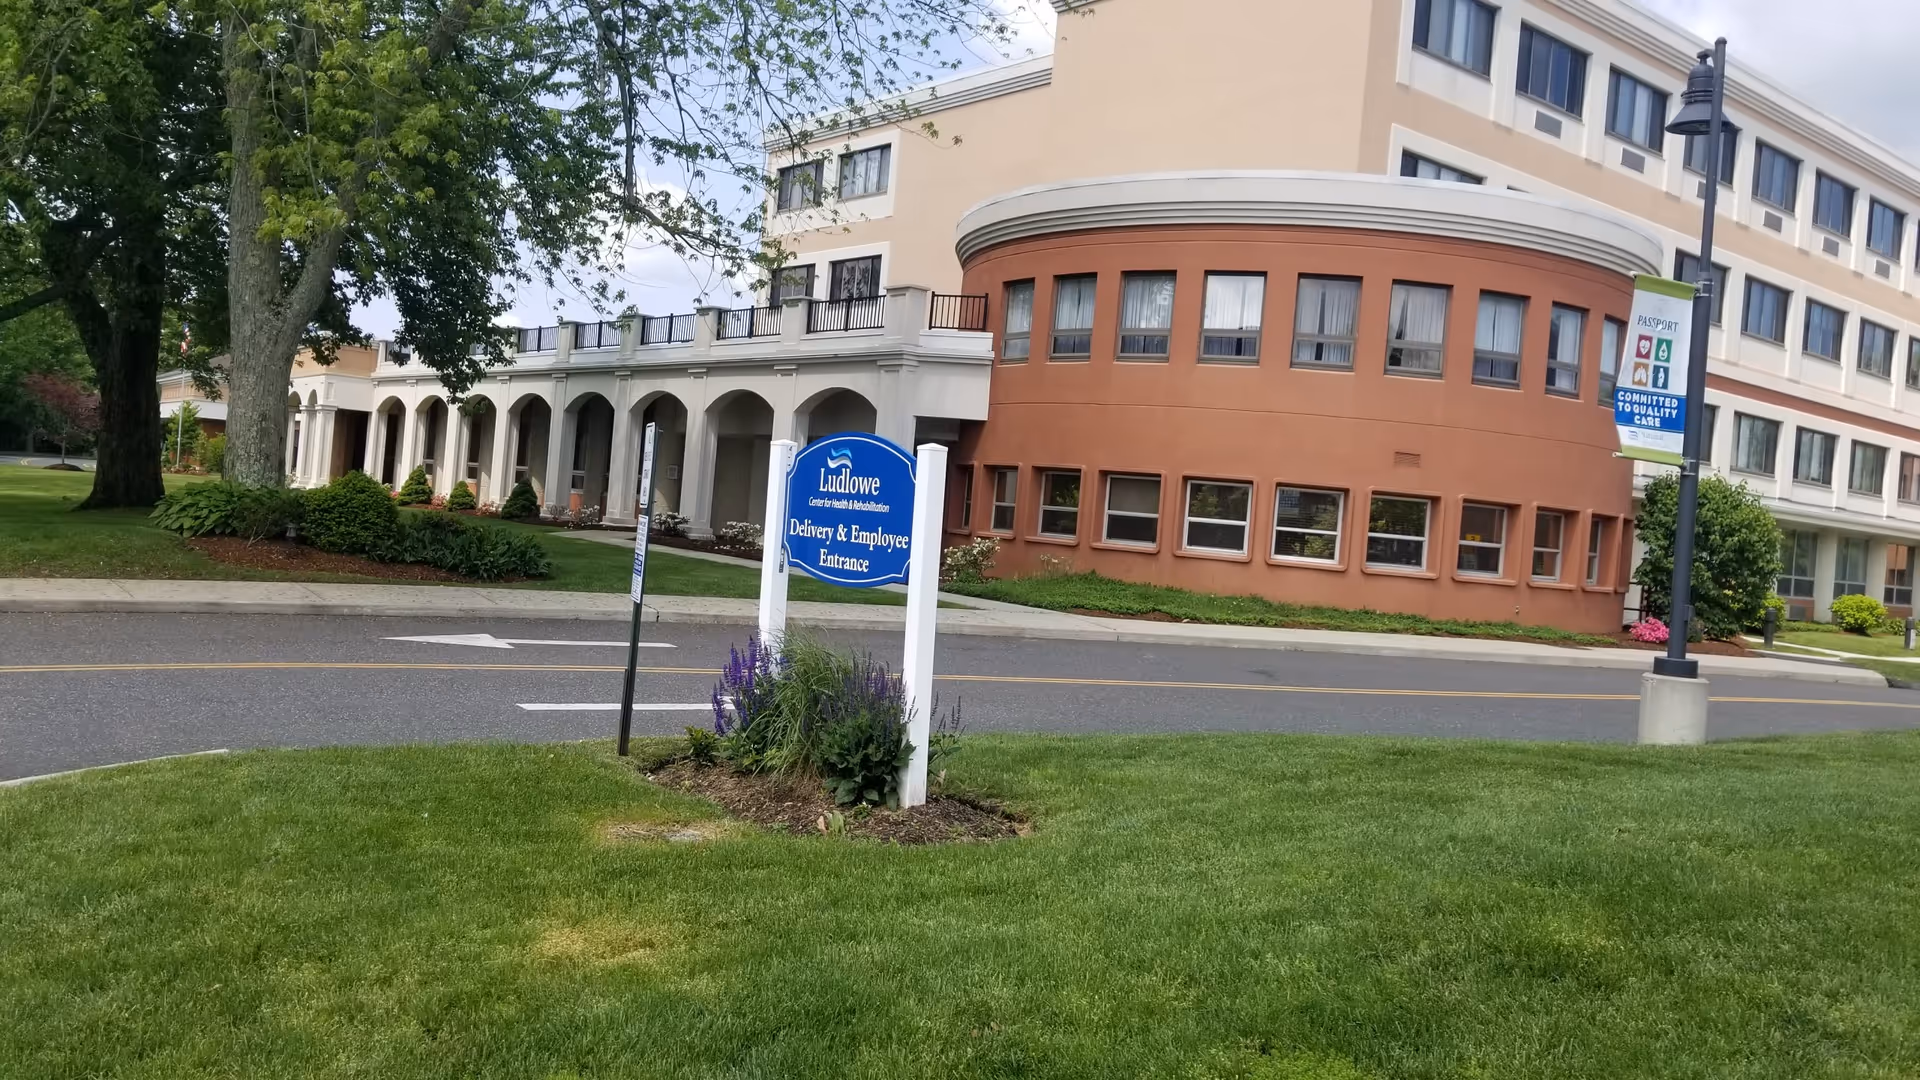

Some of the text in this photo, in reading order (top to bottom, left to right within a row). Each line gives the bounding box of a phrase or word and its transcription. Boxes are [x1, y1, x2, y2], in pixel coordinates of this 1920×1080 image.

[1637, 315, 1679, 332] PASSPORT
[1618, 391, 1678, 408] COMMITTED
[1617, 402, 1678, 418] TO QUALITY
[1634, 415, 1661, 427] CARE
[819, 468, 880, 495] Ludlowe
[809, 497, 824, 507] Center
[824, 498, 832, 508] for
[832, 499, 848, 509] Health
[853, 500, 889, 513] Rehabilitation
[790, 518, 909, 552] Delivery & Employee
[819, 548, 869, 572] Entrance
